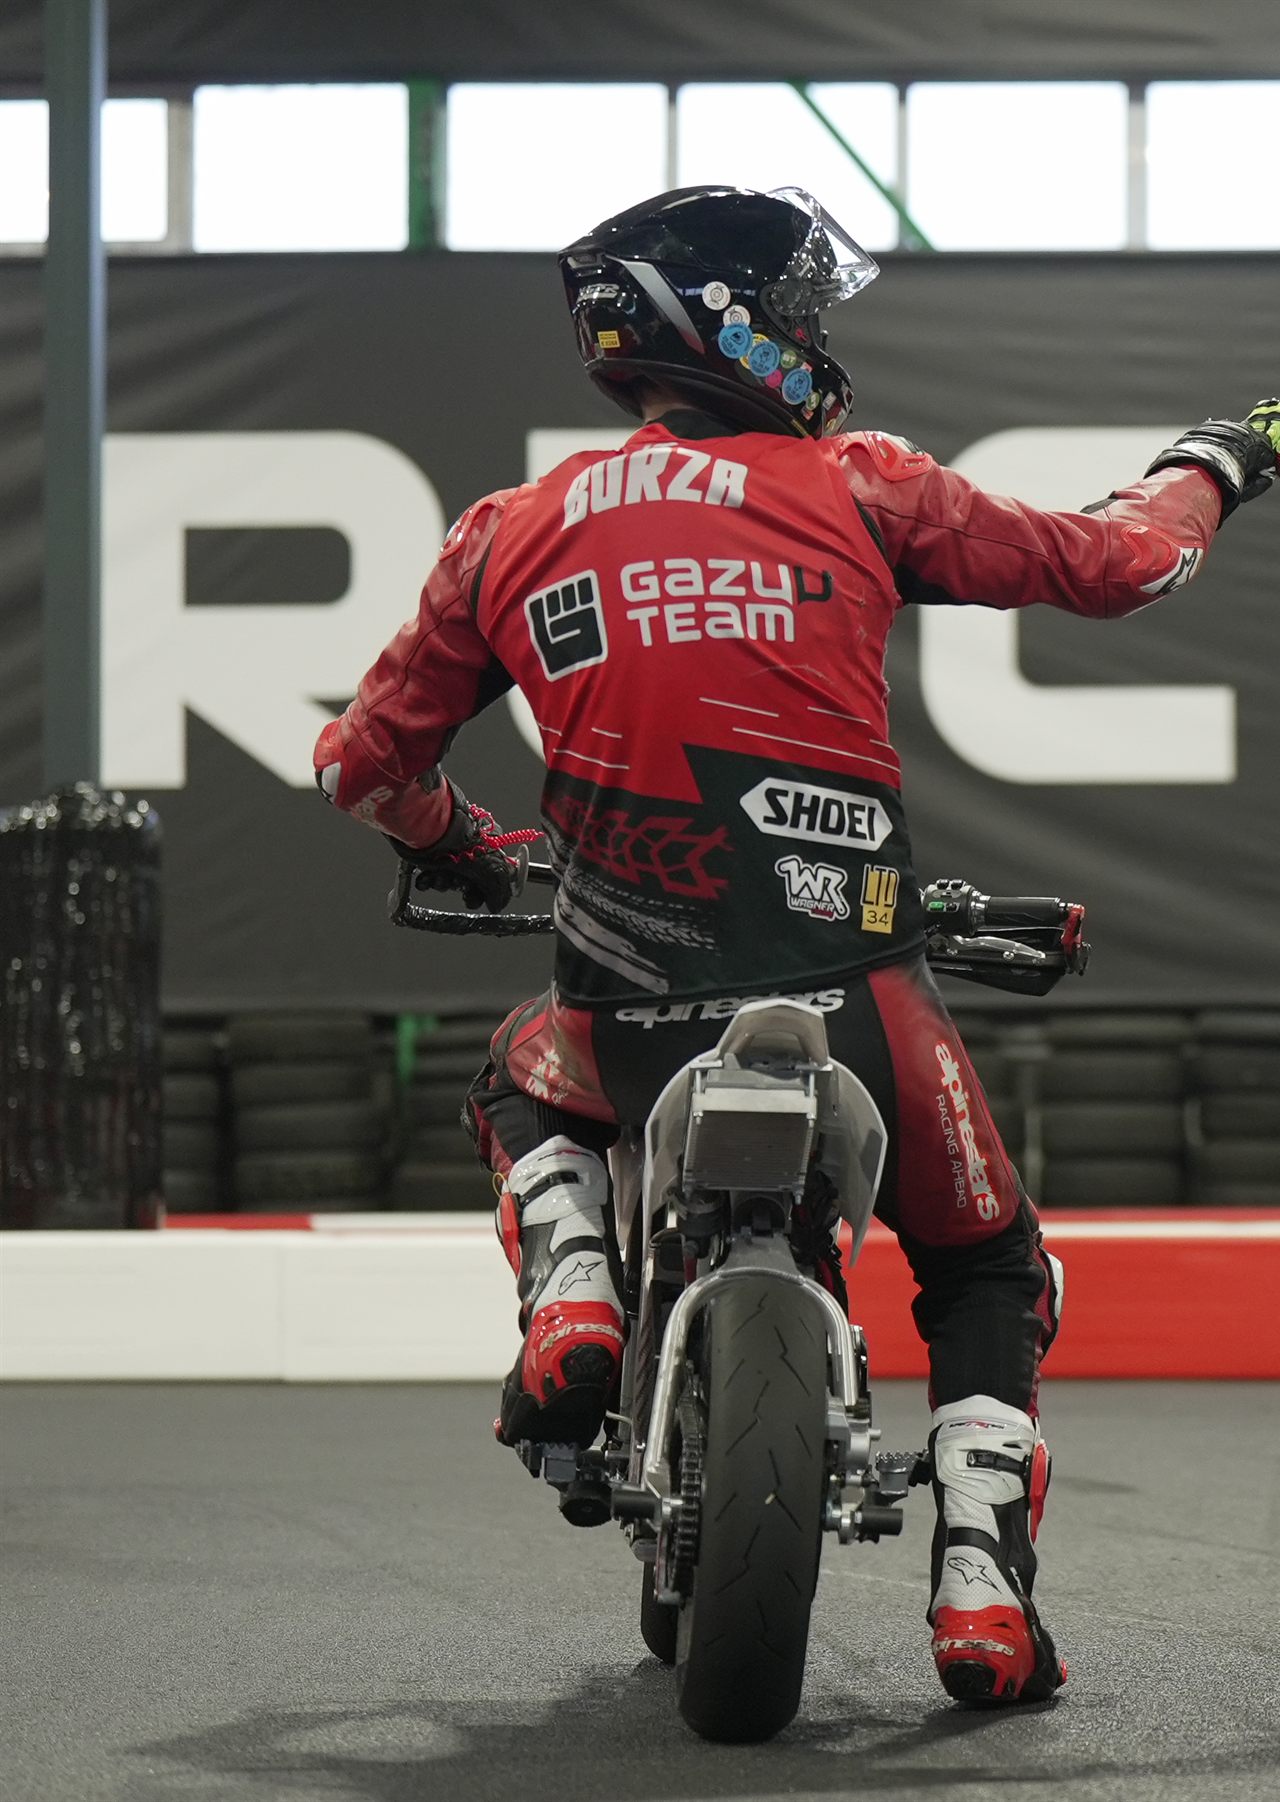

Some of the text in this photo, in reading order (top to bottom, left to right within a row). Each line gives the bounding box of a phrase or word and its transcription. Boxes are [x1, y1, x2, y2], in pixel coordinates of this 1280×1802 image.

[561, 443, 748, 531] BURZA
[762, 788, 878, 842] SHOEI
[790, 896, 835, 912] WAGNER
[866, 910, 889, 927] 34
[936, 1094, 967, 1209] RACING AHEAD
